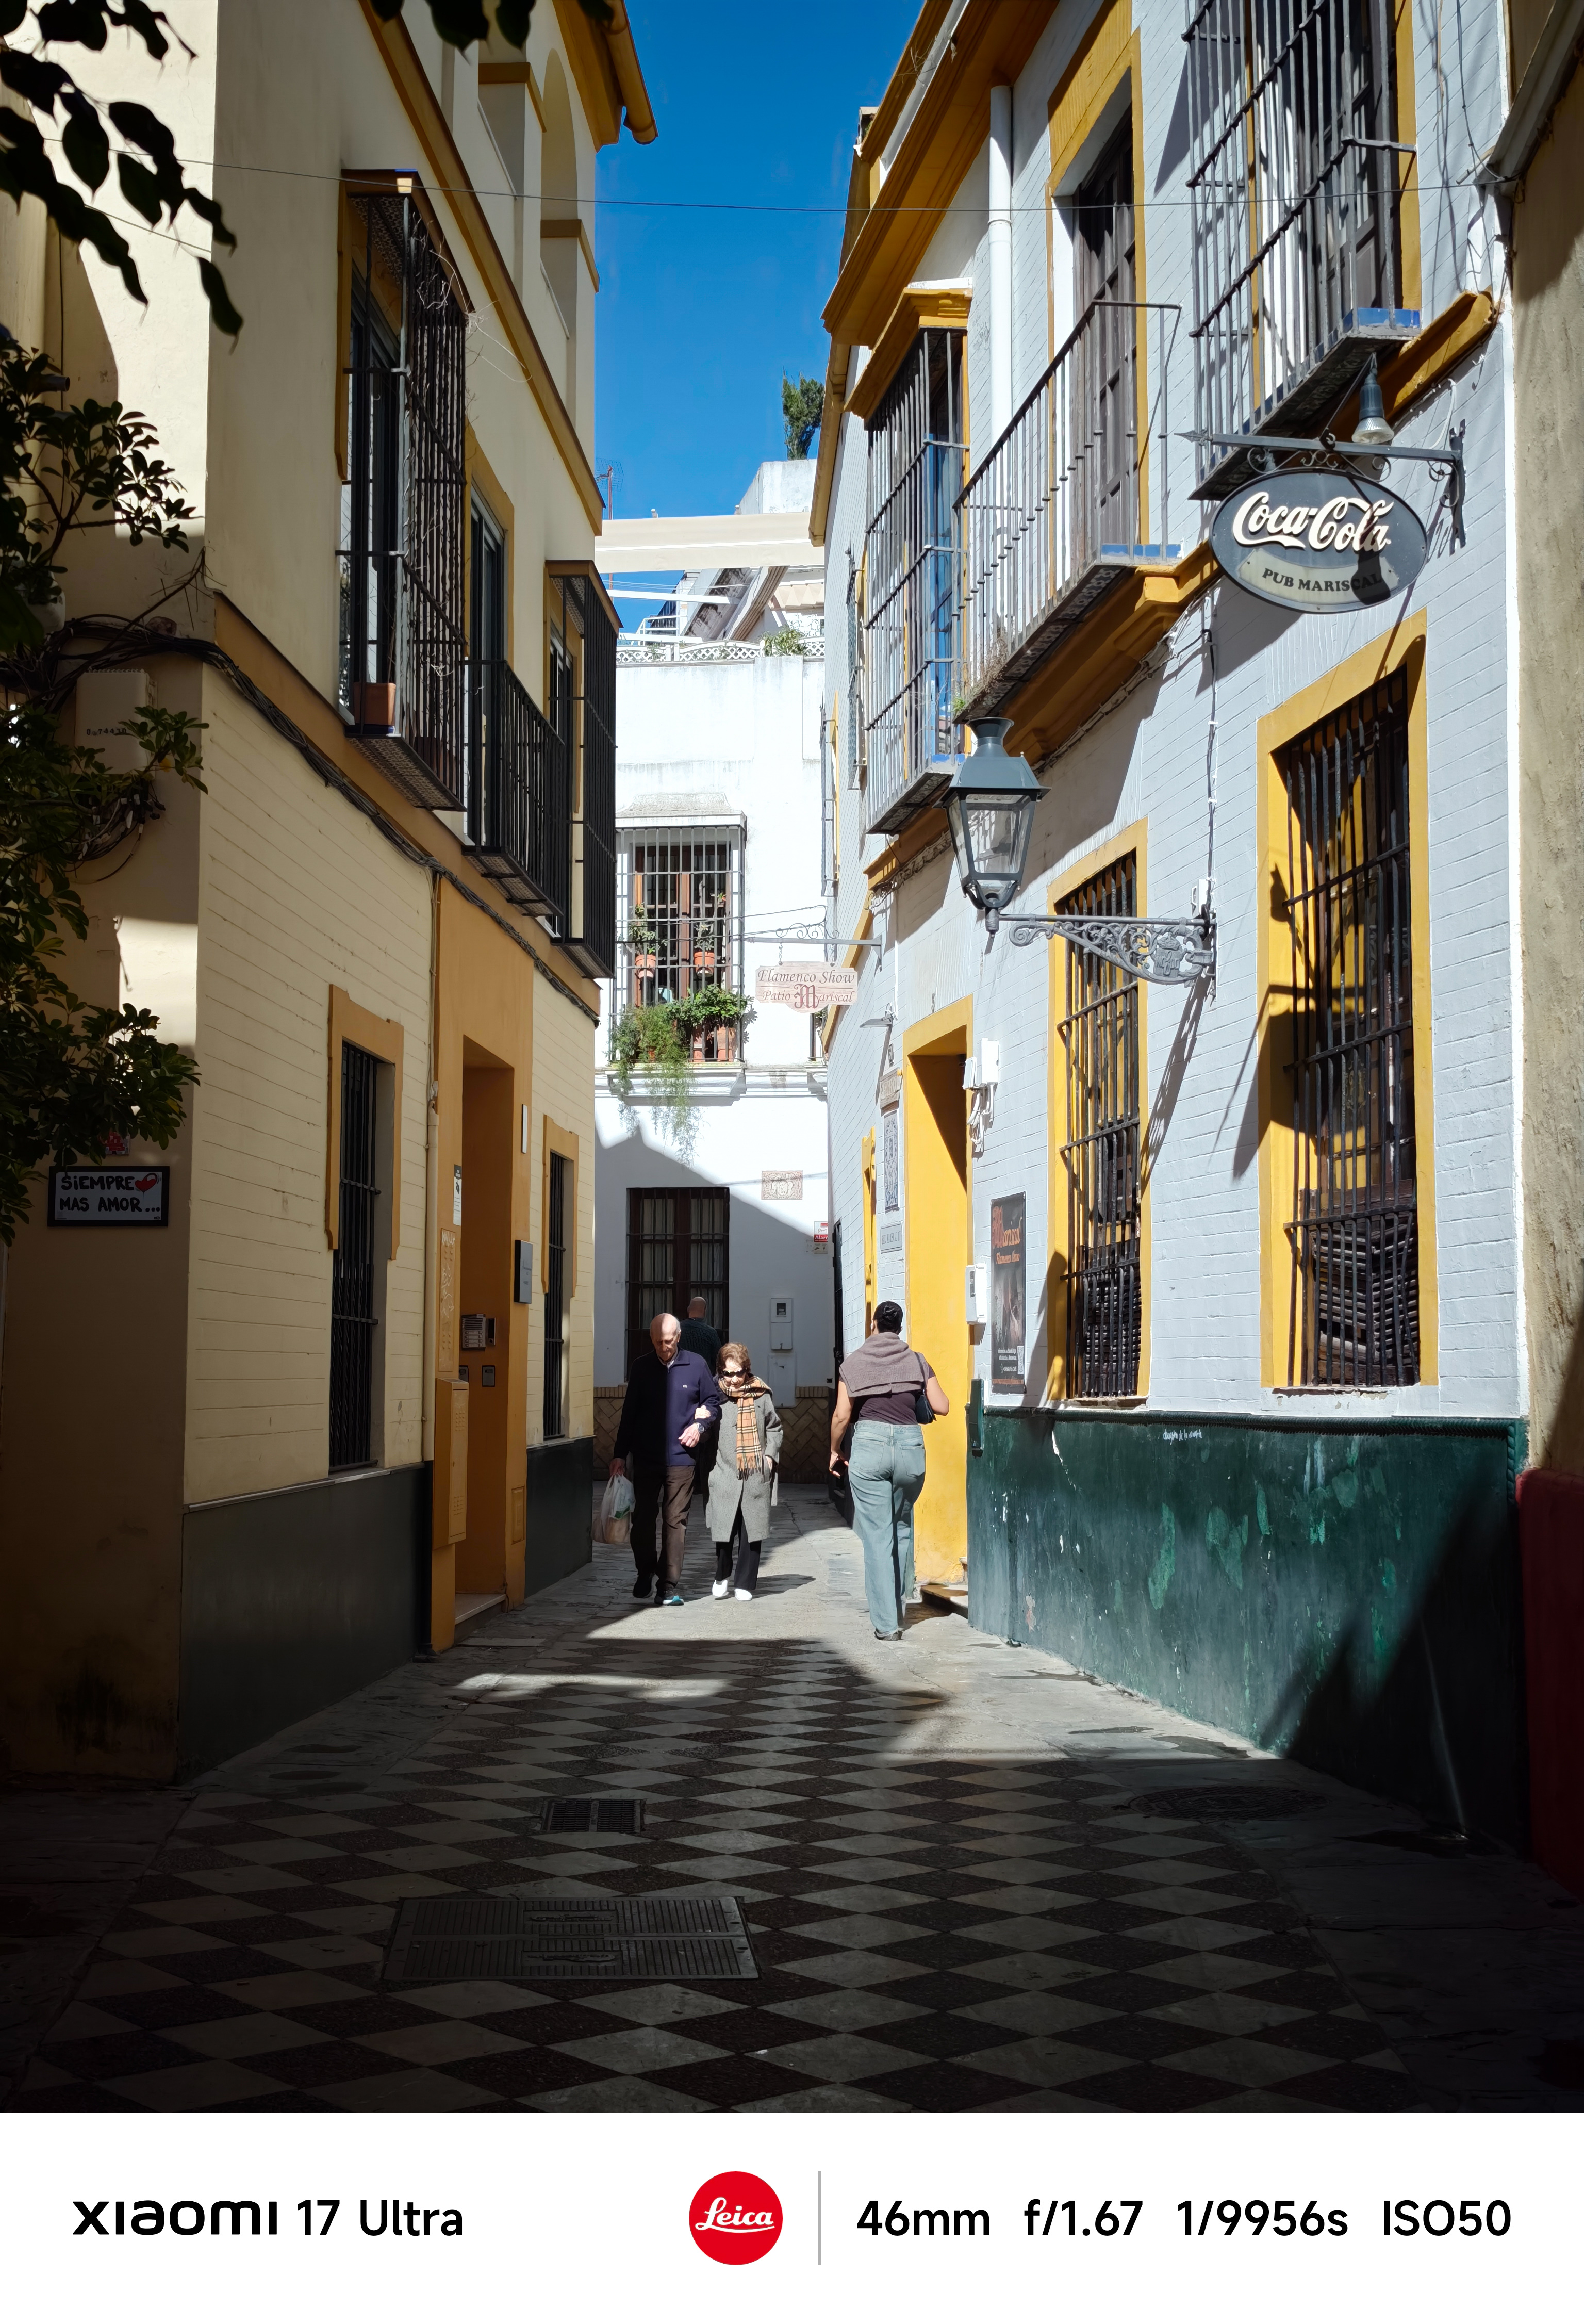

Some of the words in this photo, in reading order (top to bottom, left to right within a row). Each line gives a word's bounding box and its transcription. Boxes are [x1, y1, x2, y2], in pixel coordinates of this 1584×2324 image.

[1233, 492, 1393, 552] Coca-Cola
[1262, 567, 1294, 587] PUB
[1298, 573, 1382, 592] MARISCAL
[758, 969, 816, 983] Flamenco
[819, 969, 855, 984] Show
[762, 990, 791, 1001] Patio
[794, 984, 855, 1009] Mariscal
[59, 1197, 90, 1212] MAS
